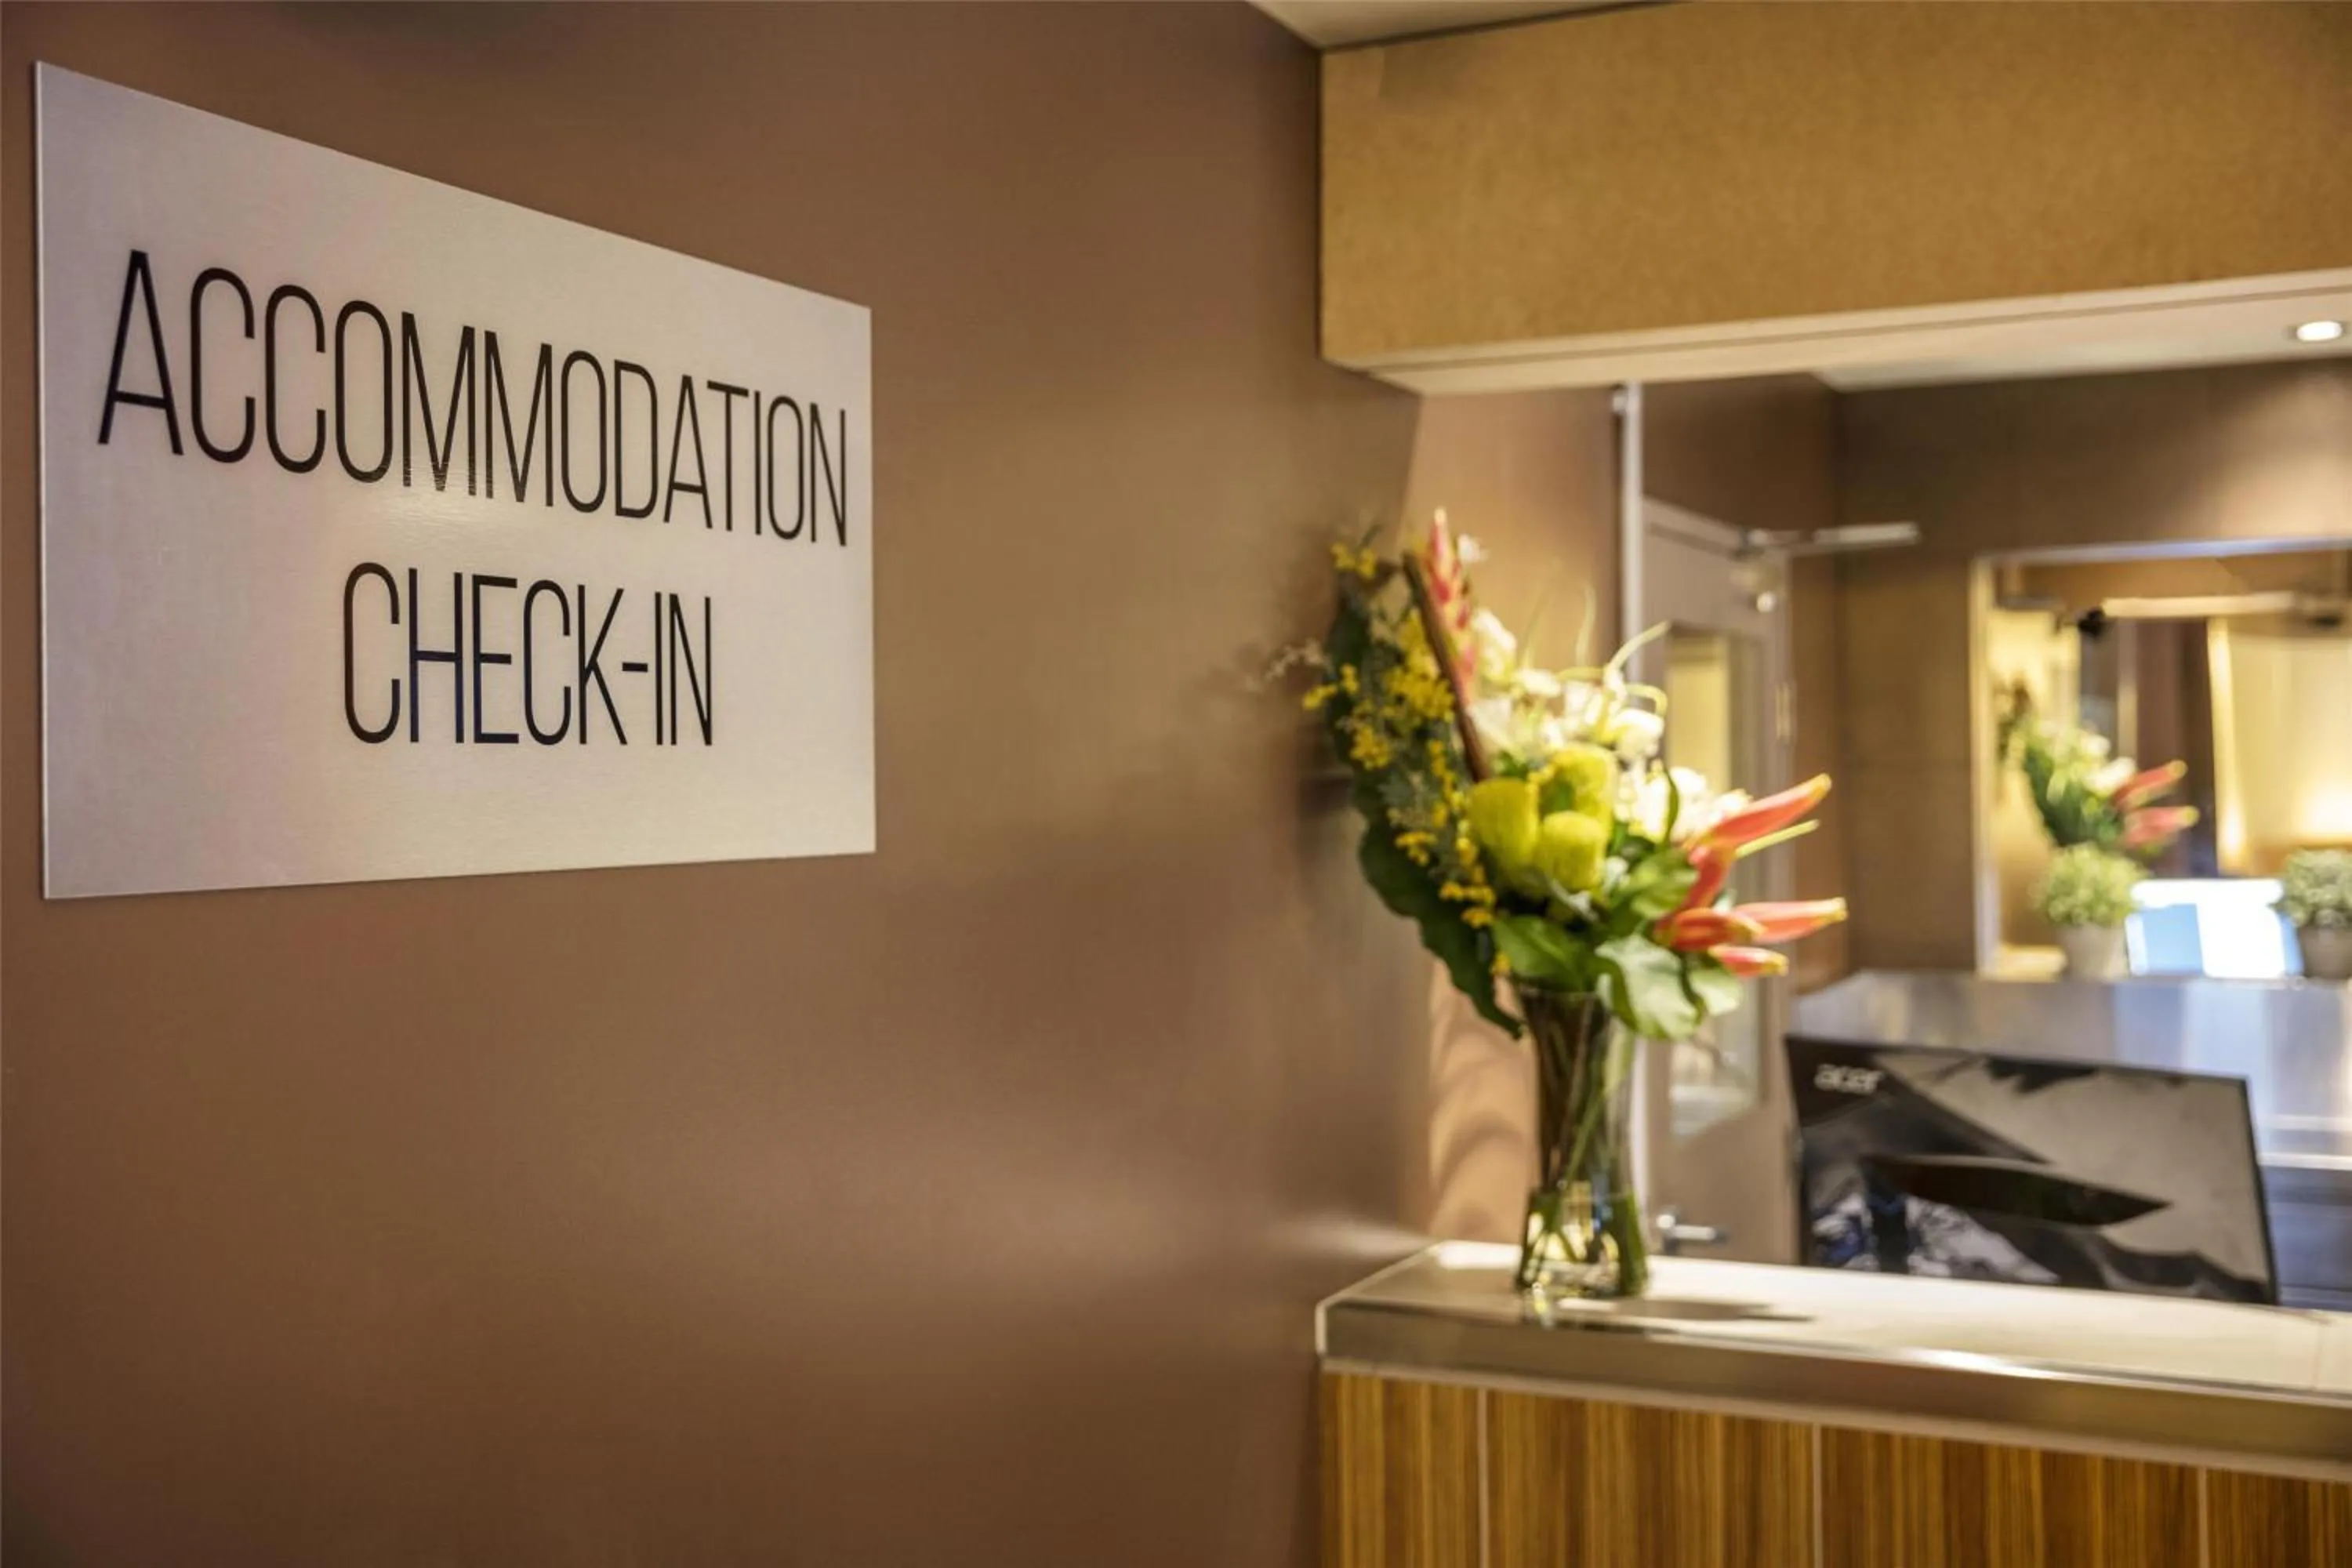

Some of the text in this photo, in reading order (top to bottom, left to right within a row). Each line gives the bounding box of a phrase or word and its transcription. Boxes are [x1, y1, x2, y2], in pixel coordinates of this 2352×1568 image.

[98, 249, 848, 546] ACCOMMODATION
[343, 562, 713, 746] CHECK-IN
[1814, 1063, 1882, 1094] acer
